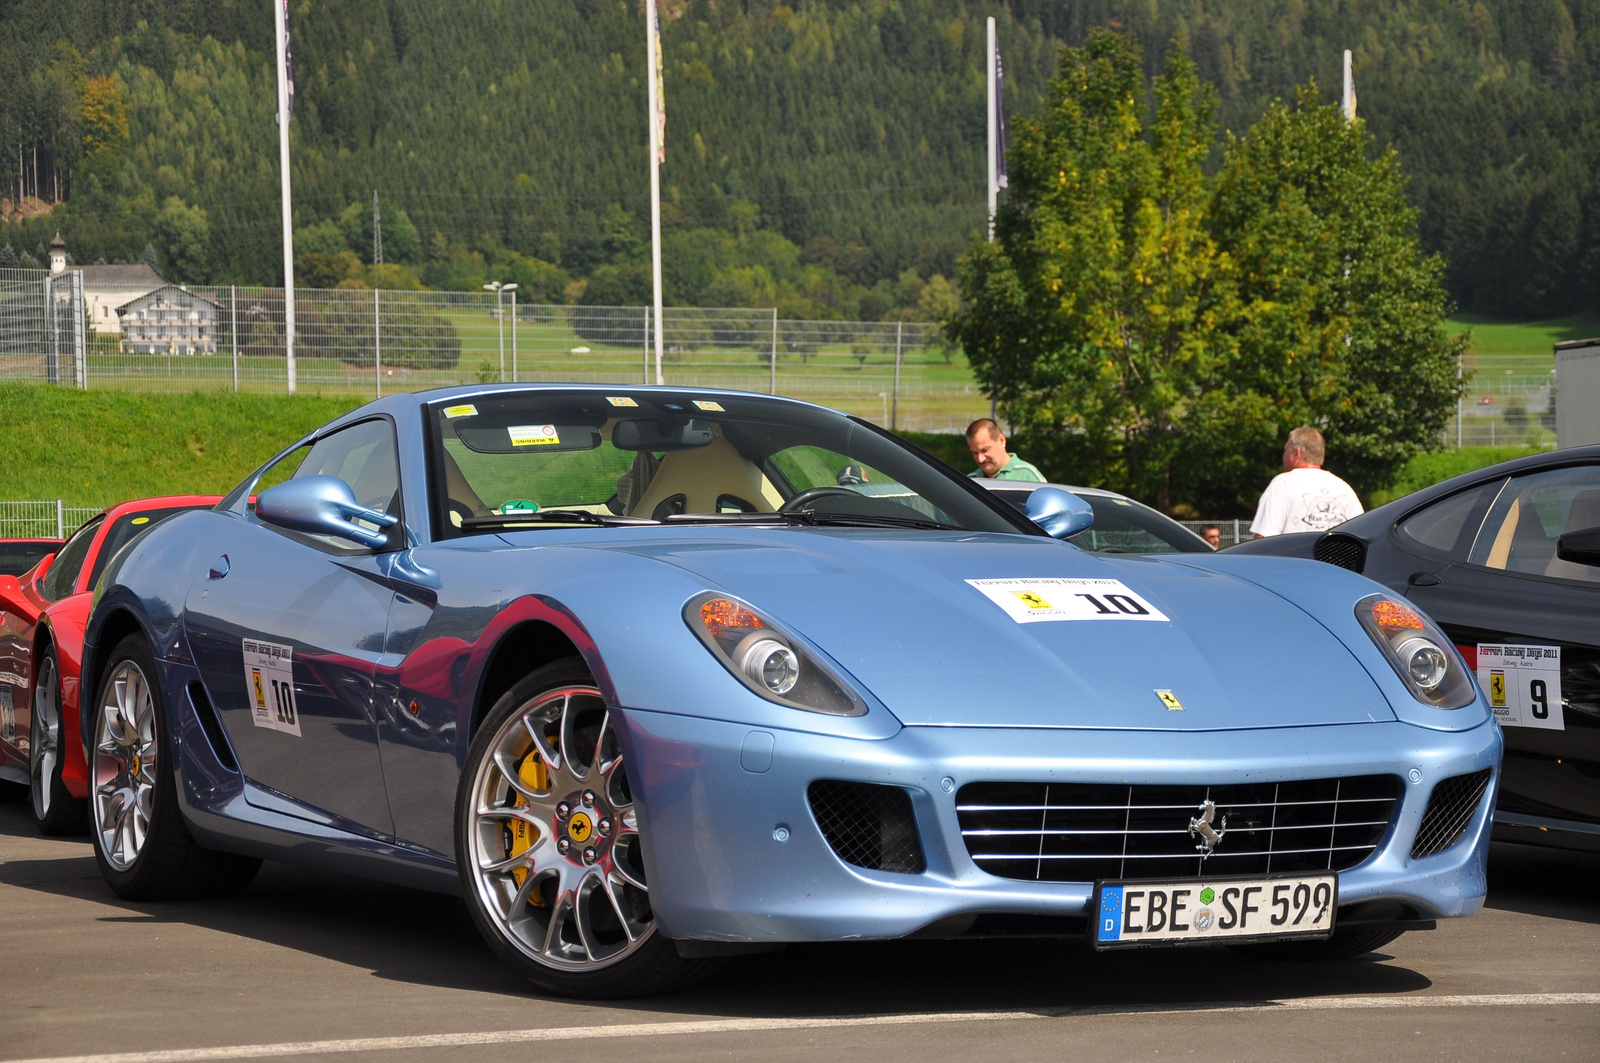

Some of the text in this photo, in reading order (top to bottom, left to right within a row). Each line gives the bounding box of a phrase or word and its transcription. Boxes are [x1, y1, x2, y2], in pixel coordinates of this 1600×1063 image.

[515, 501, 525, 509] 4
[1074, 593, 1150, 615] 10
[244, 641, 291, 660] Ferrari Racing Days 2011
[1479, 646, 1558, 660] Ferrari Racing Days 2011
[271, 679, 295, 726] 10
[1530, 679, 1549, 720] 9
[1123, 882, 1331, 933] EBE SF 599
[1104, 919, 1114, 931] D
